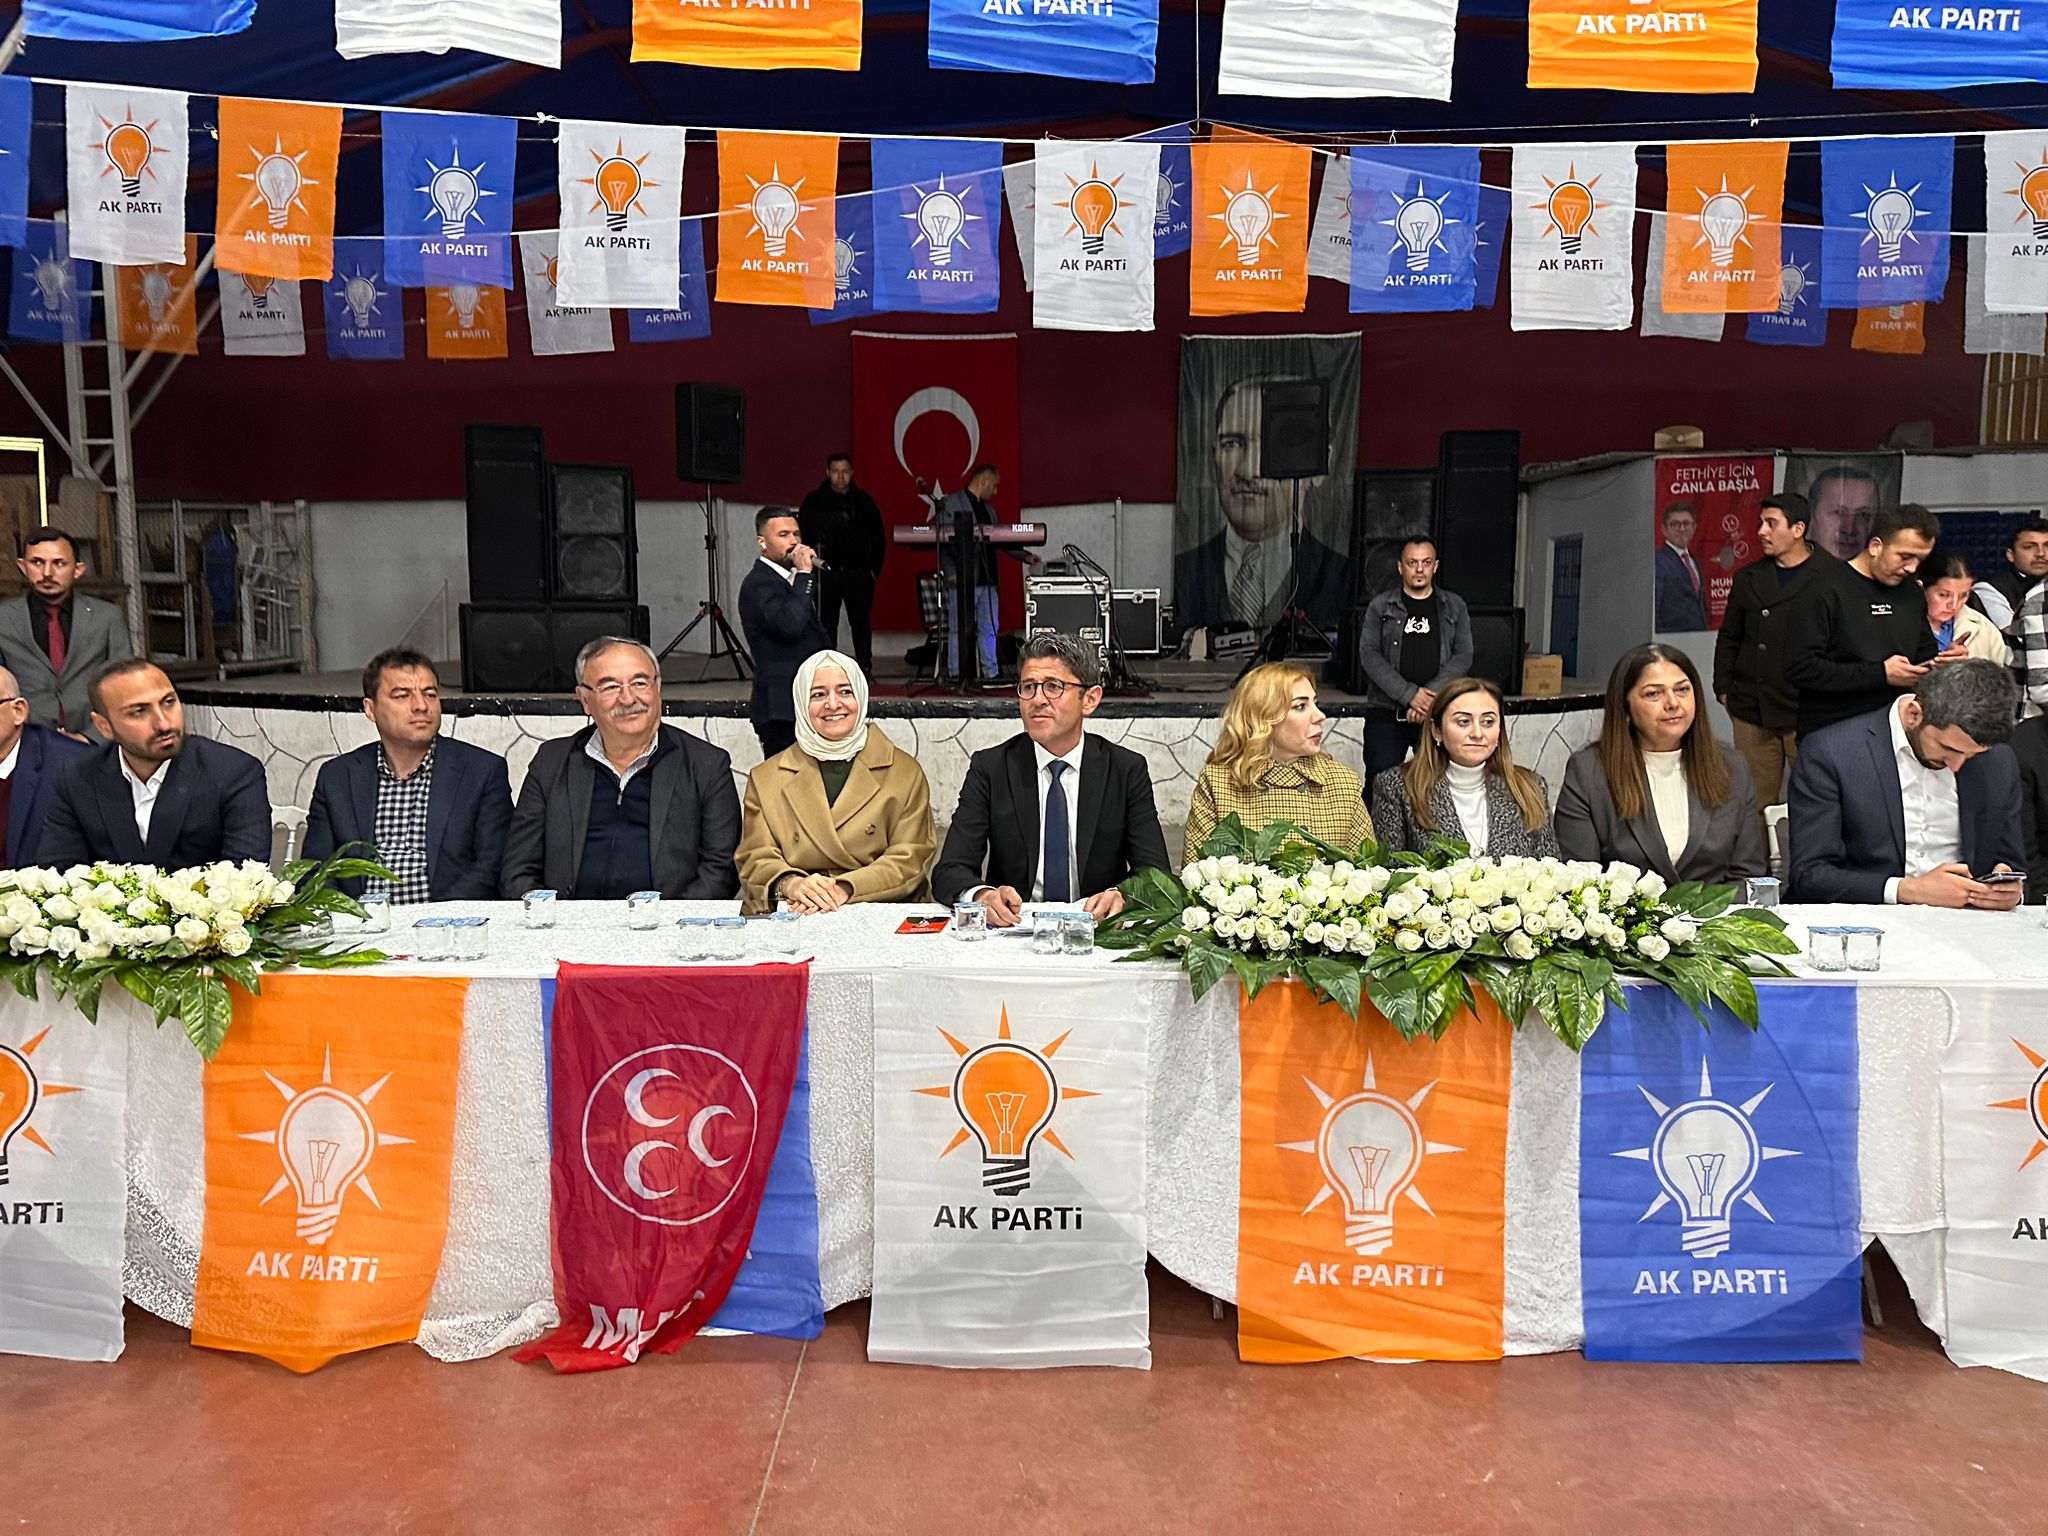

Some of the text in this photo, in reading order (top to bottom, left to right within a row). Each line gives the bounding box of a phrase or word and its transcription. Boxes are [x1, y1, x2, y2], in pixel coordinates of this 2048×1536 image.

[982, 0, 1023, 15] AK
[1575, 15, 1616, 34] AK
[1889, 8, 1931, 29] AK
[99, 201, 121, 213] AK
[244, 230, 267, 243] AK
[585, 236, 605, 248] AK
[420, 243, 441, 254] AK
[741, 259, 762, 271] AK
[1060, 259, 1080, 271] AK
[1539, 259, 1558, 270] AK
[907, 269, 928, 280] AK
[1215, 269, 1236, 281] AK
[1687, 270, 1708, 282] AK
[1857, 266, 1878, 277] AK
[1384, 275, 1405, 286] AK
[1670, 478, 1760, 495] CANLA BAŞLA
[1012, 524, 1034, 533] KORG
[1711, 577, 1733, 587] MUH
[933, 1205, 979, 1230] AK
[246, 1252, 293, 1279] AK
[1293, 1262, 1341, 1286] AK
[1633, 1270, 1682, 1295] AK
